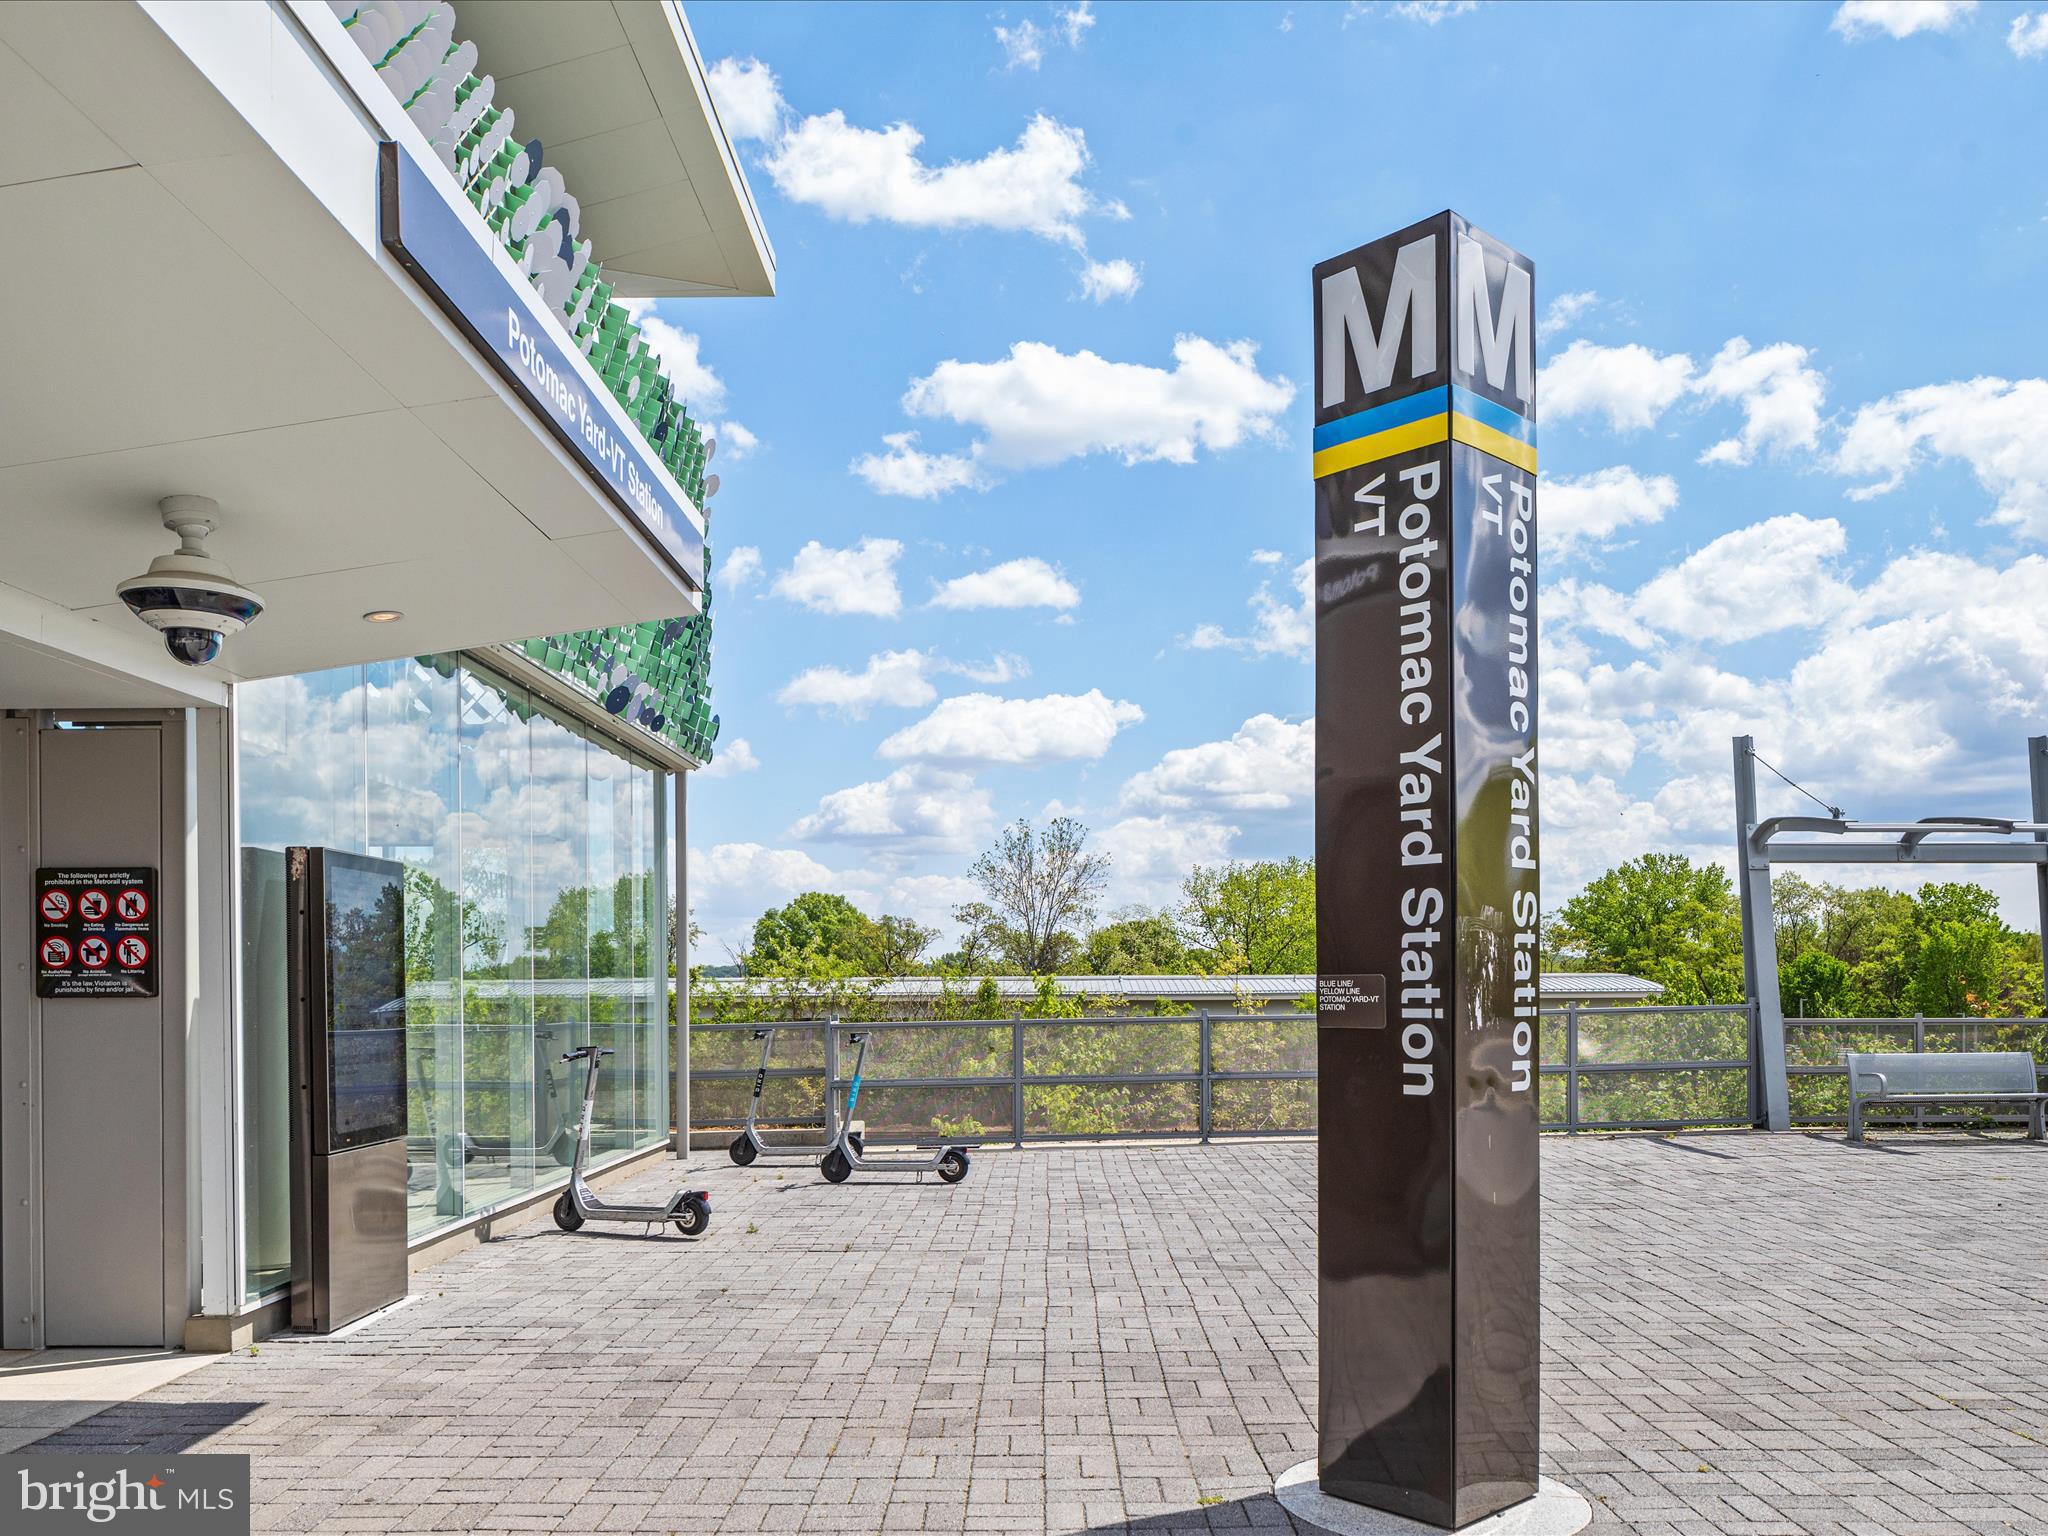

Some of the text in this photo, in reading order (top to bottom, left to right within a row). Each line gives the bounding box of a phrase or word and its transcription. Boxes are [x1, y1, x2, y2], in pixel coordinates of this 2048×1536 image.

[1322, 234, 1437, 409] M
[1457, 232, 1531, 405] M
[508, 307, 663, 529] Potomac Yard-VT Station
[1354, 473, 1386, 536] VT
[1482, 473, 1503, 536] VT
[1398, 460, 1444, 1096] Potomac Yard Station
[1508, 480, 1538, 1092] Potomac Yard Station
[109, 872, 130, 880] strictly
